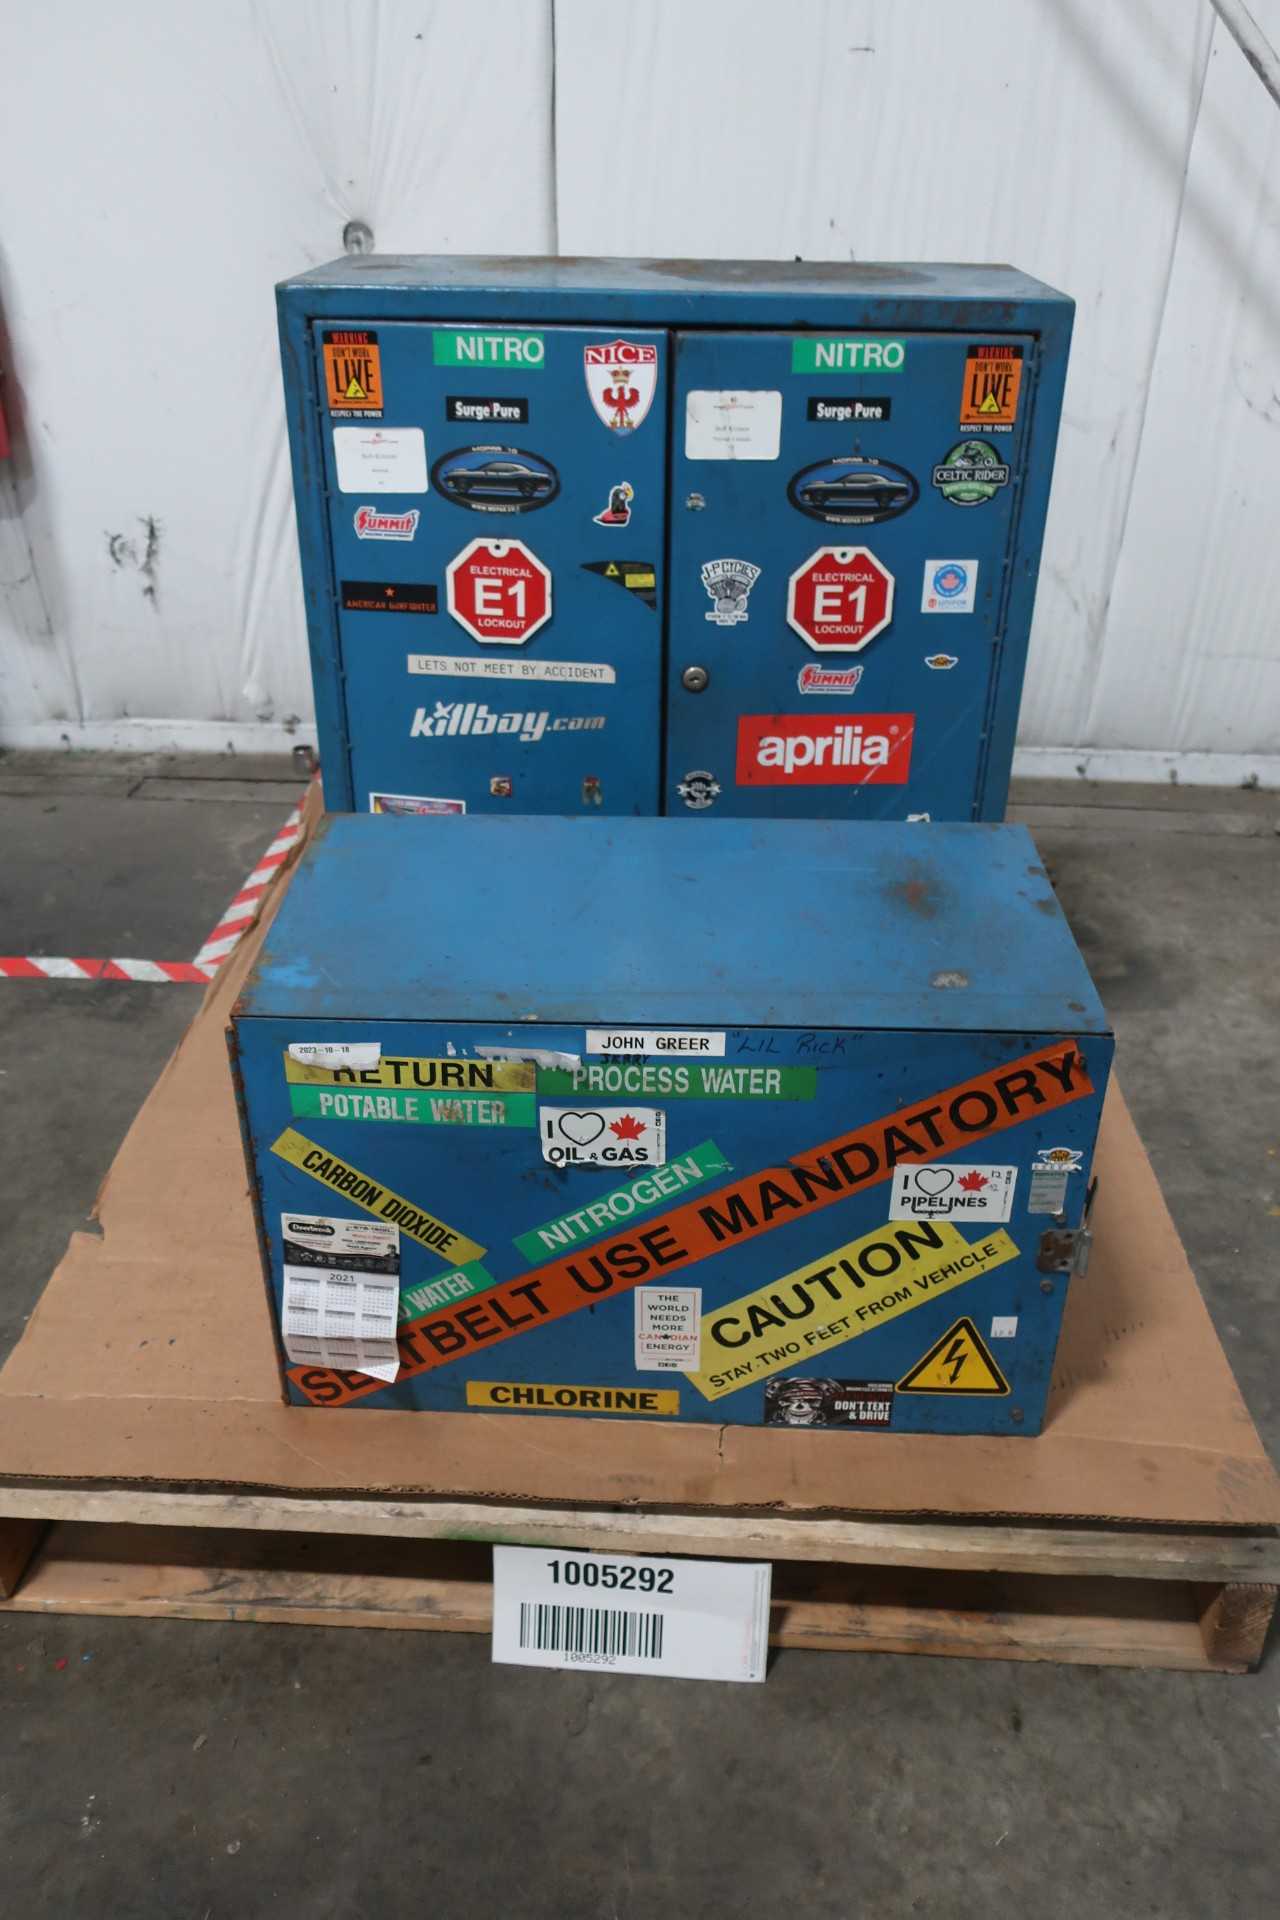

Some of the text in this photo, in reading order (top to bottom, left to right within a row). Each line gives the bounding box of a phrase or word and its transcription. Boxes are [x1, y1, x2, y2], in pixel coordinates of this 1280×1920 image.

[456, 335, 544, 363] NITRO
[586, 346, 656, 363] NICE
[815, 342, 905, 369] NITRO
[332, 359, 376, 393] LIVE
[970, 373, 1014, 408] LIVE
[455, 401, 521, 420] Surge Pure
[816, 402, 883, 421] Surge Pure
[936, 469, 1006, 481] CELTIC RIDER
[470, 565, 533, 579] ELECTRICAL
[812, 572, 875, 584] ELECTRICAL
[474, 577, 526, 618] E1
[813, 585, 867, 623] E1
[478, 617, 526, 629] LOCKOUT
[815, 624, 864, 635] LOCKOUT
[418, 659, 605, 679] LETS NOT MEET BY ACCIDENT
[757, 725, 889, 773] aprilia
[602, 1036, 710, 1050] JOHN GREER
[572, 1065, 782, 1095] PROCESS WATER
[320, 1092, 506, 1124] POTABLE WATER
[547, 1120, 553, 1139] I
[548, 1147, 585, 1162] OIL
[590, 1152, 599, 1160] &
[602, 1147, 649, 1161] GAS
[903, 1175, 909, 1190] I
[302, 1149, 384, 1208] CARBON
[380, 1198, 459, 1253] DIOXIDE
[537, 1156, 704, 1250] NITROGEN
[901, 1196, 988, 1209] PIPELINES
[301, 1280, 550, 1402] SETBELT
[567, 1225, 689, 1294] USE
[698, 1051, 1077, 1242] MANDATORY
[330, 1273, 355, 1282] 2021
[711, 1220, 944, 1349] CAUTION
[406, 1272, 475, 1311] WATER
[709, 1243, 999, 1388] STAY TWO FEET FROM VEHICLE
[646, 1343, 690, 1351] ENERGY
[490, 1386, 658, 1410] CHLORINE
[834, 1401, 891, 1410] DON'T TEXT
[849, 1411, 890, 1420] & DRIVE
[547, 1559, 675, 1594] 1005292
[563, 1651, 617, 1666] 1005292
